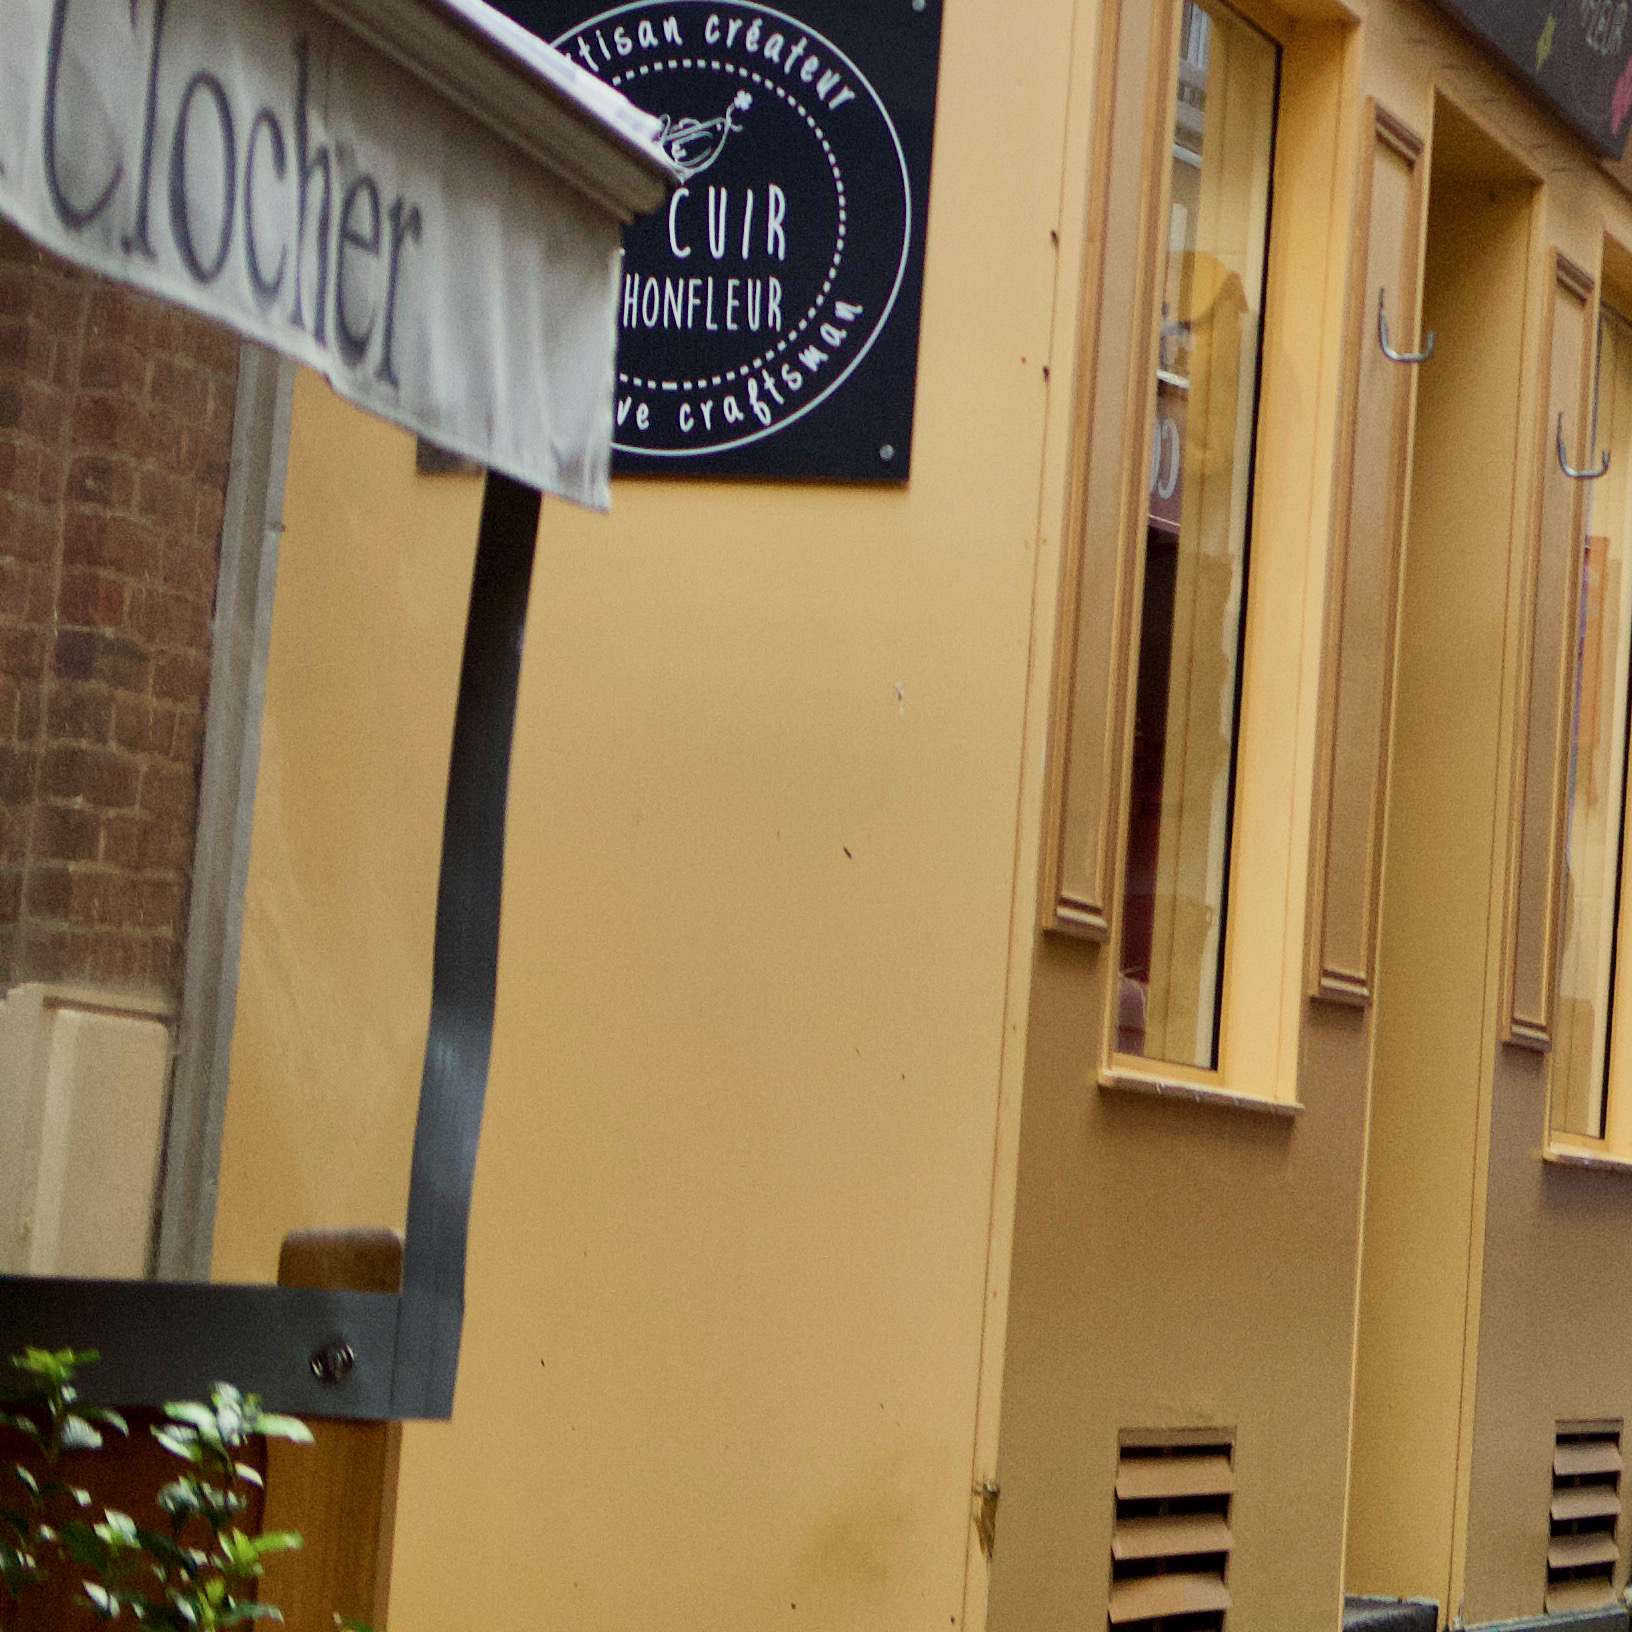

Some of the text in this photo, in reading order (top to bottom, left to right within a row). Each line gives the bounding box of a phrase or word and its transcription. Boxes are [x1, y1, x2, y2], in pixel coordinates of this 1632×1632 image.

[566, 14, 856, 111] tisan créateur
[669, 183, 787, 261] CUIR
[622, 272, 783, 332] HONFLEUR
[678, 300, 864, 432] craftsman
